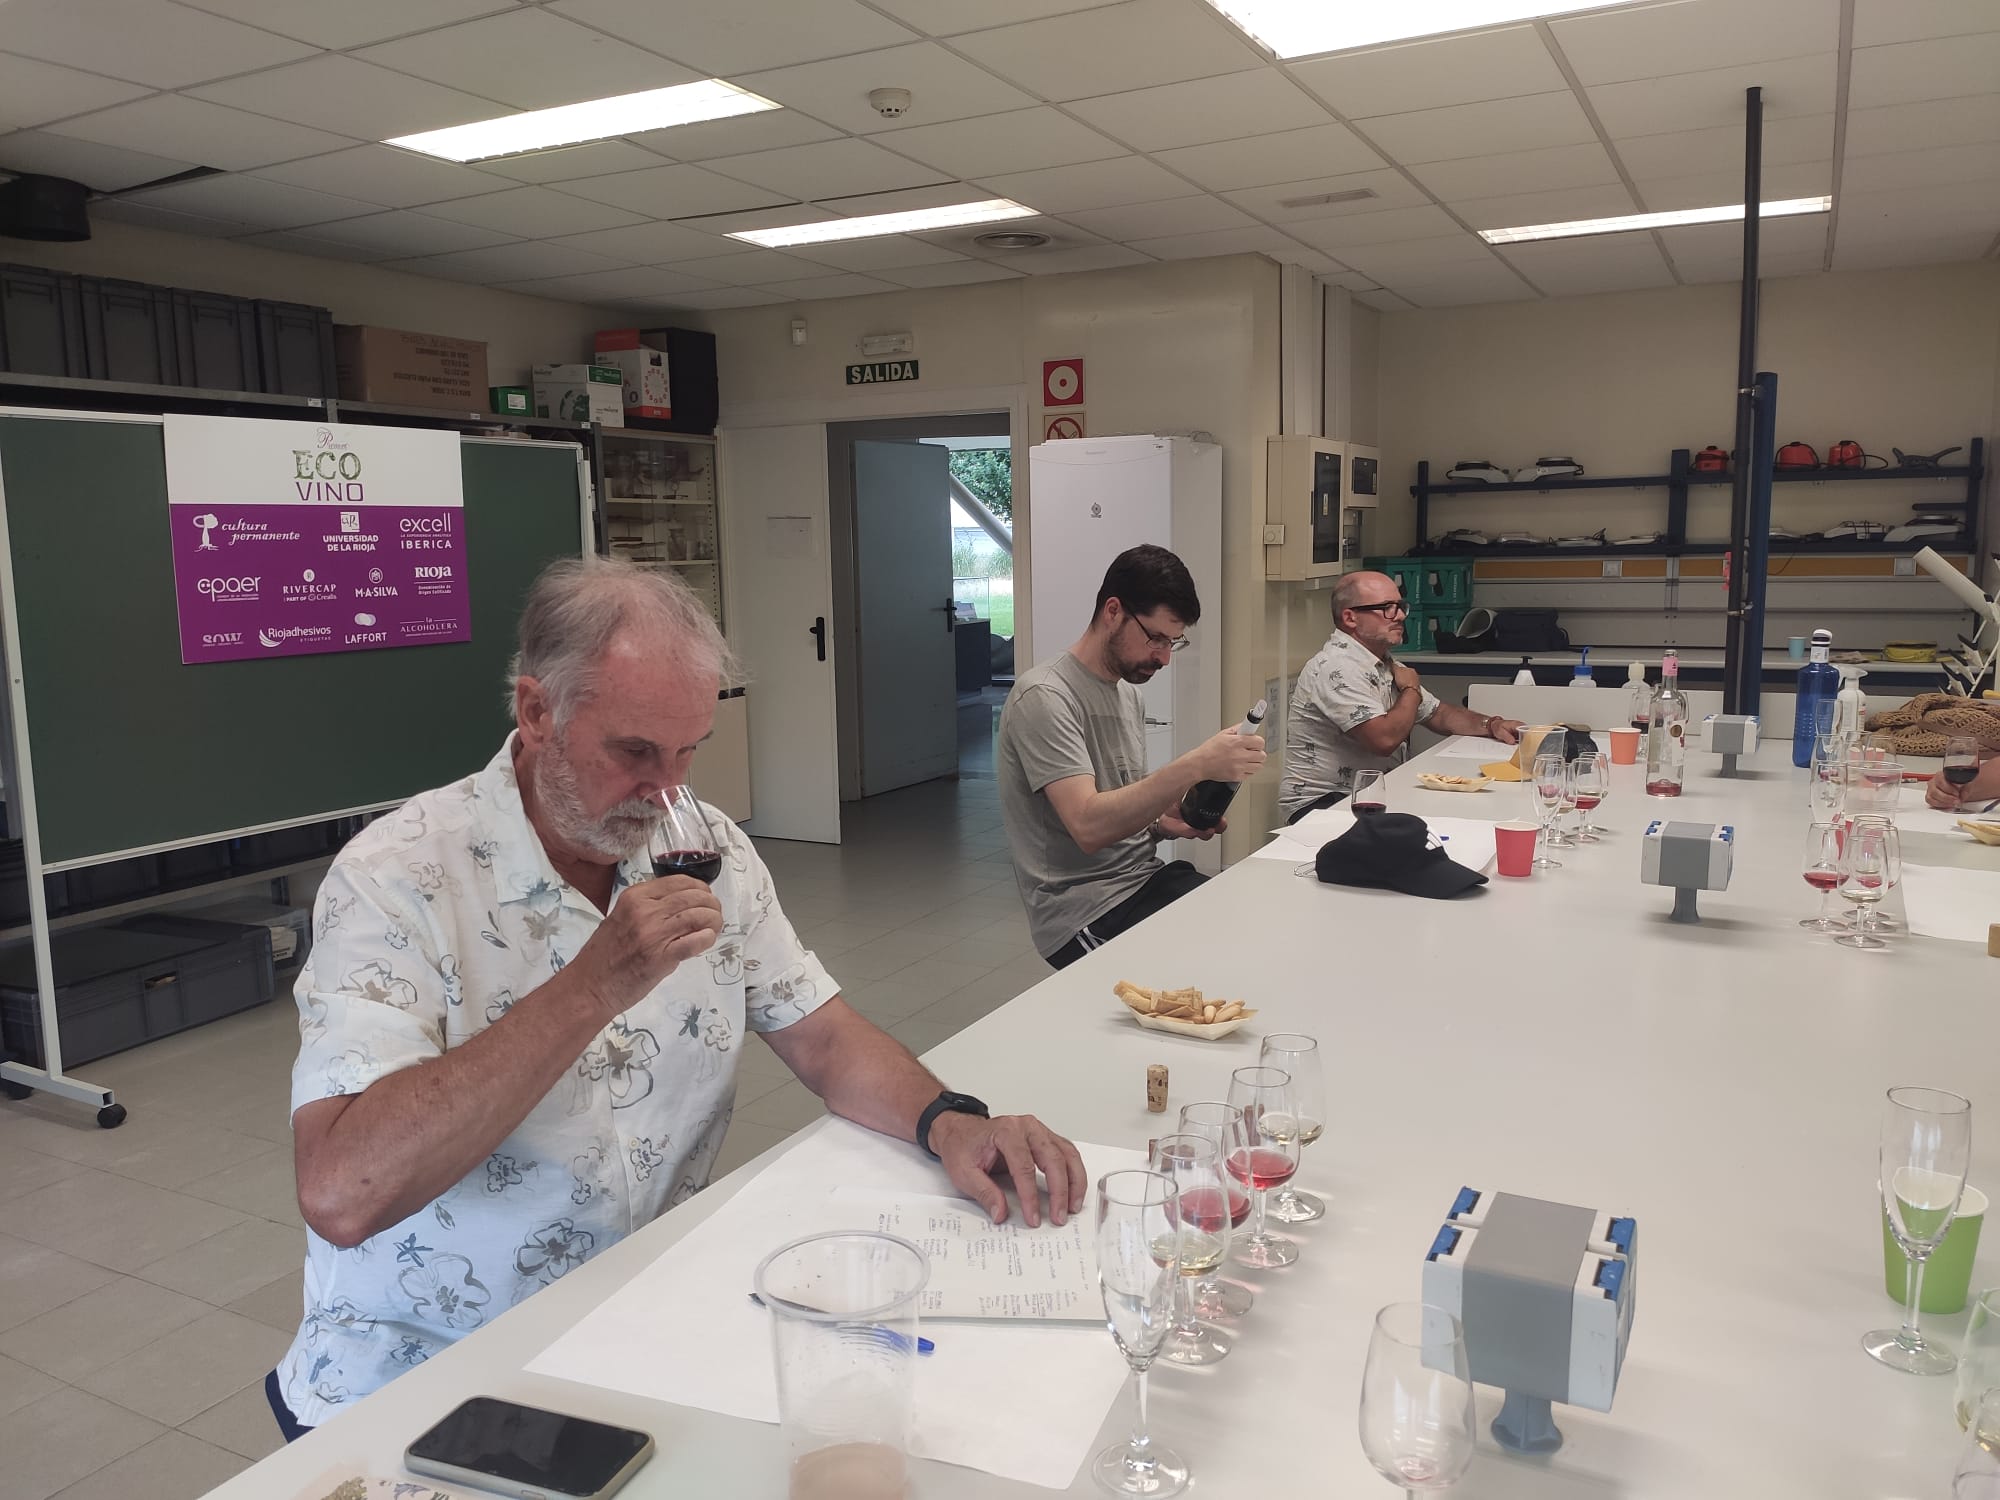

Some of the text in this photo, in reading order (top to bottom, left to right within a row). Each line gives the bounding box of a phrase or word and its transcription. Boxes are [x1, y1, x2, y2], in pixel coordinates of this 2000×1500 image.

[851, 362, 914, 384] SALIDA
[292, 450, 362, 480] ECO
[296, 482, 364, 501] VINO
[221, 518, 269, 531] cultura
[399, 512, 452, 532] excell
[227, 531, 301, 546] permanente
[322, 534, 379, 543] UNIVERSIDAD
[400, 540, 452, 549] IBERICA
[327, 543, 376, 552] DE LA RIOJA
[283, 584, 337, 594] RIVERCAP
[268, 626, 332, 641] Riojadhesivos
[400, 622, 458, 633] ALCOHOLERA
[345, 632, 388, 644] LAFFORT
